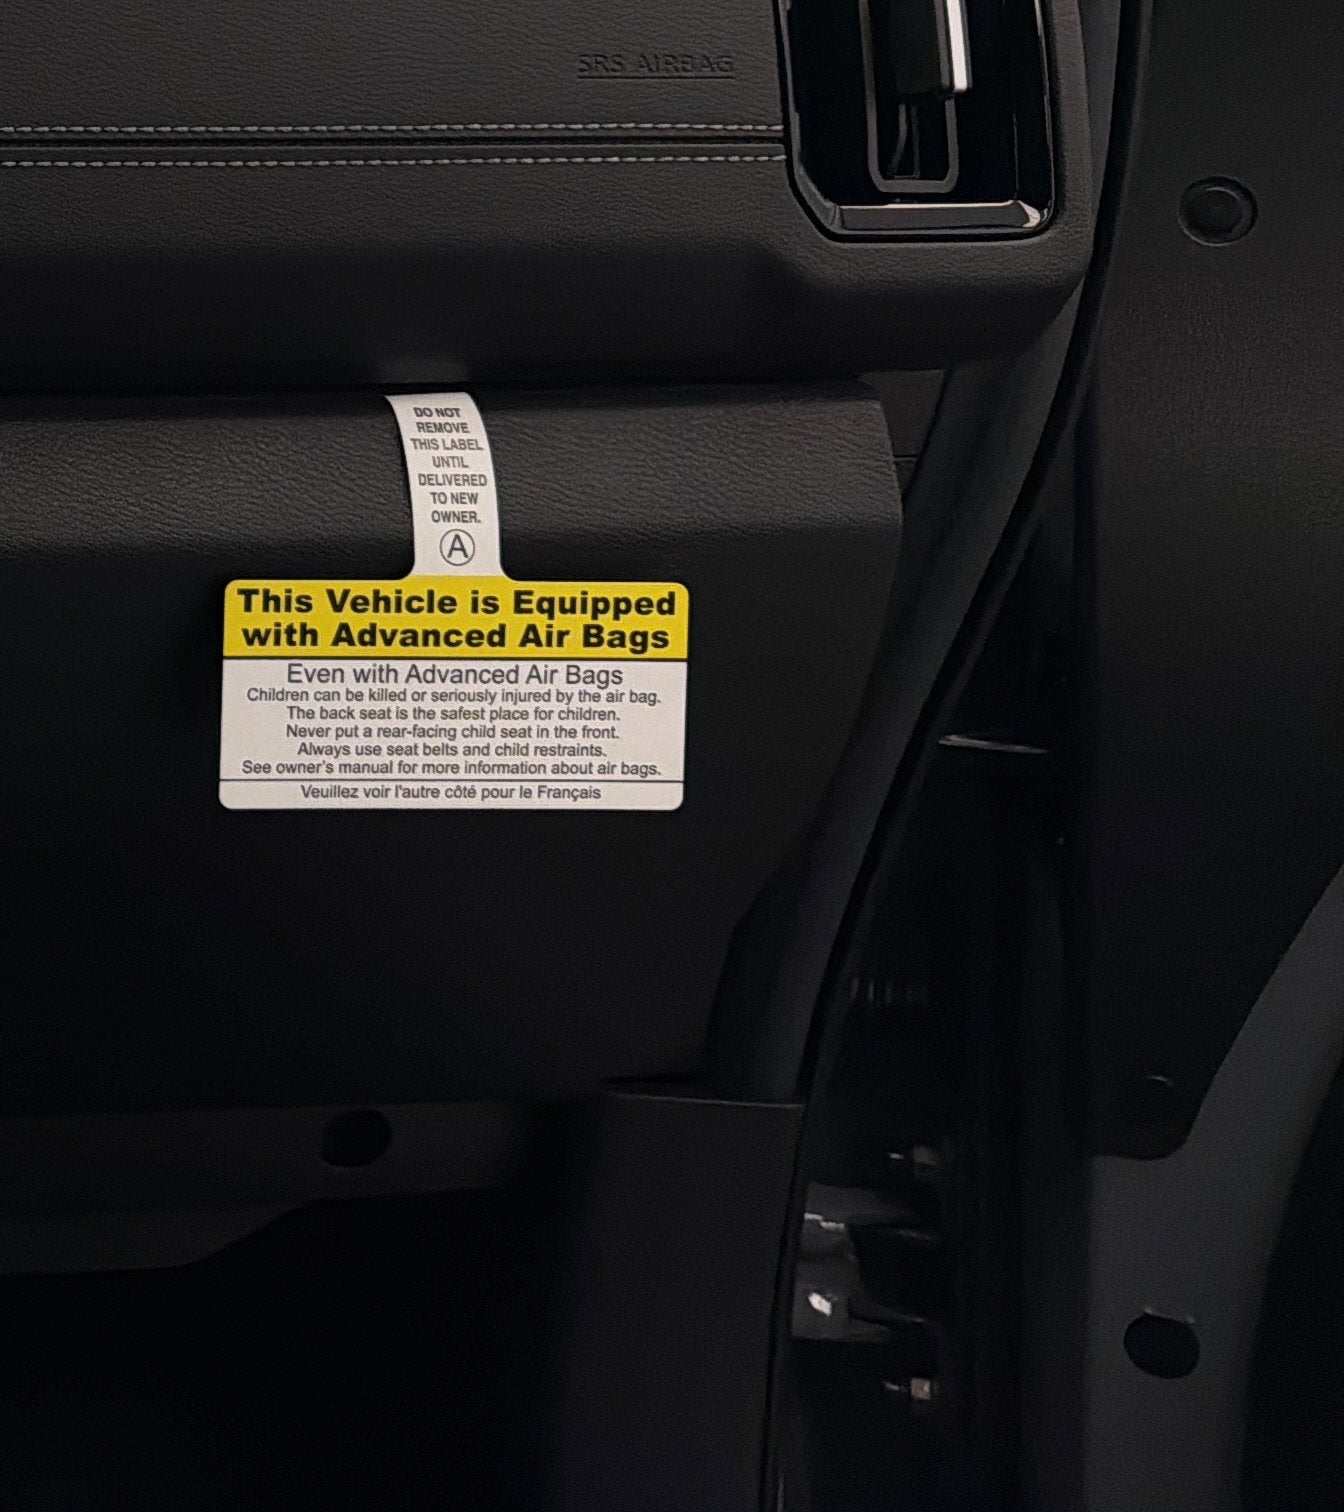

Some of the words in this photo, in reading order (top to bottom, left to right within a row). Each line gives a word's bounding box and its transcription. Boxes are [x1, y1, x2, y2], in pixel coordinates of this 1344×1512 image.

[577, 53, 624, 73] SRS
[638, 53, 734, 73] AIRBAG
[413, 407, 433, 417] DO
[435, 408, 460, 418] NOT
[416, 422, 470, 433] REMOVE
[410, 438, 439, 450] THIS
[442, 439, 484, 451] LABEL
[432, 455, 469, 468] UNTIL
[418, 473, 487, 486] DELIVERED
[430, 491, 447, 504] TO
[451, 492, 478, 504] NEW
[431, 510, 481, 523] OWNER.
[237, 588, 313, 613] This
[326, 589, 457, 614] Vehicle
[471, 590, 499, 614] is
[514, 590, 675, 621] Equipped
[242, 622, 318, 646] with
[331, 623, 506, 647] Advanced
[519, 624, 570, 647] Air
[583, 624, 669, 654] Bags
[288, 663, 344, 683] Even
[353, 663, 398, 683] with
[405, 663, 519, 684] Advanced
[525, 664, 558, 684] Air
[566, 665, 623, 688] Bags
[247, 687, 309, 702] Children
[314, 691, 341, 702] can
[345, 687, 364, 702] be
[369, 688, 407, 702] killed
[411, 691, 427, 702] or
[431, 689, 497, 705] seriously
[501, 689, 551, 705] injured
[556, 689, 574, 705] by
[578, 689, 601, 703] the
[605, 689, 625, 703] air
[629, 690, 661, 707] bag.
[286, 706, 315, 720] The
[320, 706, 355, 720] back
[359, 707, 392, 720] seat
[396, 706, 408, 720] is
[413, 706, 436, 720] the
[441, 706, 485, 720] safest
[489, 706, 529, 723] place
[534, 707, 554, 720] for
[558, 707, 620, 721] children.
[286, 724, 331, 738] Never
[335, 725, 359, 741] put
[363, 727, 372, 738] a
[377, 724, 457, 741] rear-facing
[461, 725, 496, 738] child
[501, 726, 532, 738] seat
[537, 725, 549, 738] in
[554, 725, 577, 738] the
[582, 725, 619, 739] front.
[297, 742, 351, 759] Always
[355, 745, 382, 756] use
[387, 743, 419, 756] seat
[423, 743, 458, 756] belts
[463, 743, 490, 756] and
[495, 743, 529, 756] child
[534, 743, 607, 757] restraints.
[242, 759, 272, 774] See
[276, 760, 334, 774] owner's
[339, 760, 393, 774] manual
[398, 760, 418, 774] for
[422, 763, 460, 774] more
[465, 760, 546, 774] information
[551, 761, 593, 775] about
[597, 762, 617, 775] air
[621, 762, 661, 778] bags.
[301, 784, 359, 799] Veuillez
[363, 784, 391, 798] voir
[395, 784, 440, 799] l'autre
[445, 784, 476, 798] côté
[481, 788, 515, 801] pour
[519, 785, 532, 799] le
[538, 784, 601, 802] Français
